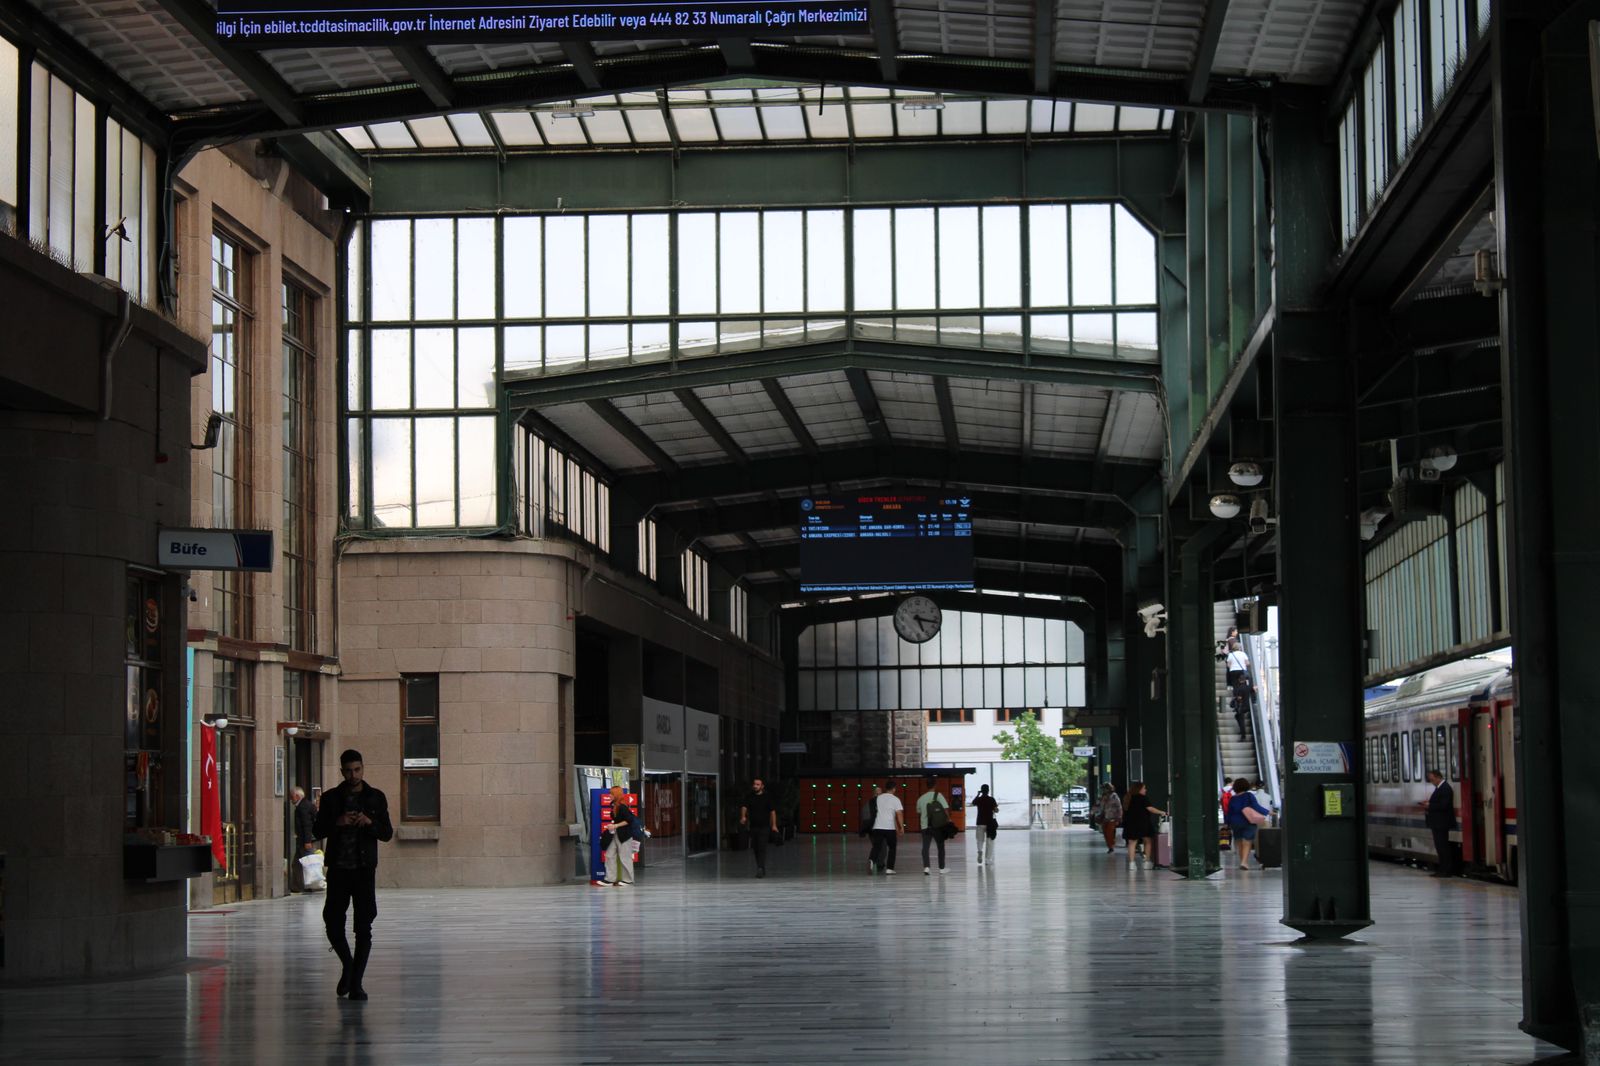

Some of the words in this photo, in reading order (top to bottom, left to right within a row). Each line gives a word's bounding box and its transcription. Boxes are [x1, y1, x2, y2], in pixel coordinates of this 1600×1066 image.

[240, 18, 261, 37] İçin
[264, 19, 426, 34] ebilet.tcddtasimacilik.gov.tr
[429, 14, 475, 30] İnternet
[478, 15, 526, 29] Adresini
[529, 15, 569, 31] Ziyaret
[573, 13, 616, 27] Edebilir
[619, 15, 646, 29] veya
[650, 12, 672, 25] 444
[675, 11, 689, 25] 82
[692, 11, 707, 24] 33
[710, 10, 762, 24] Numaralı
[765, 9, 795, 26] Çağrı
[799, 8, 867, 22] Merkezimizi
[170, 542, 207, 556] Büfe
